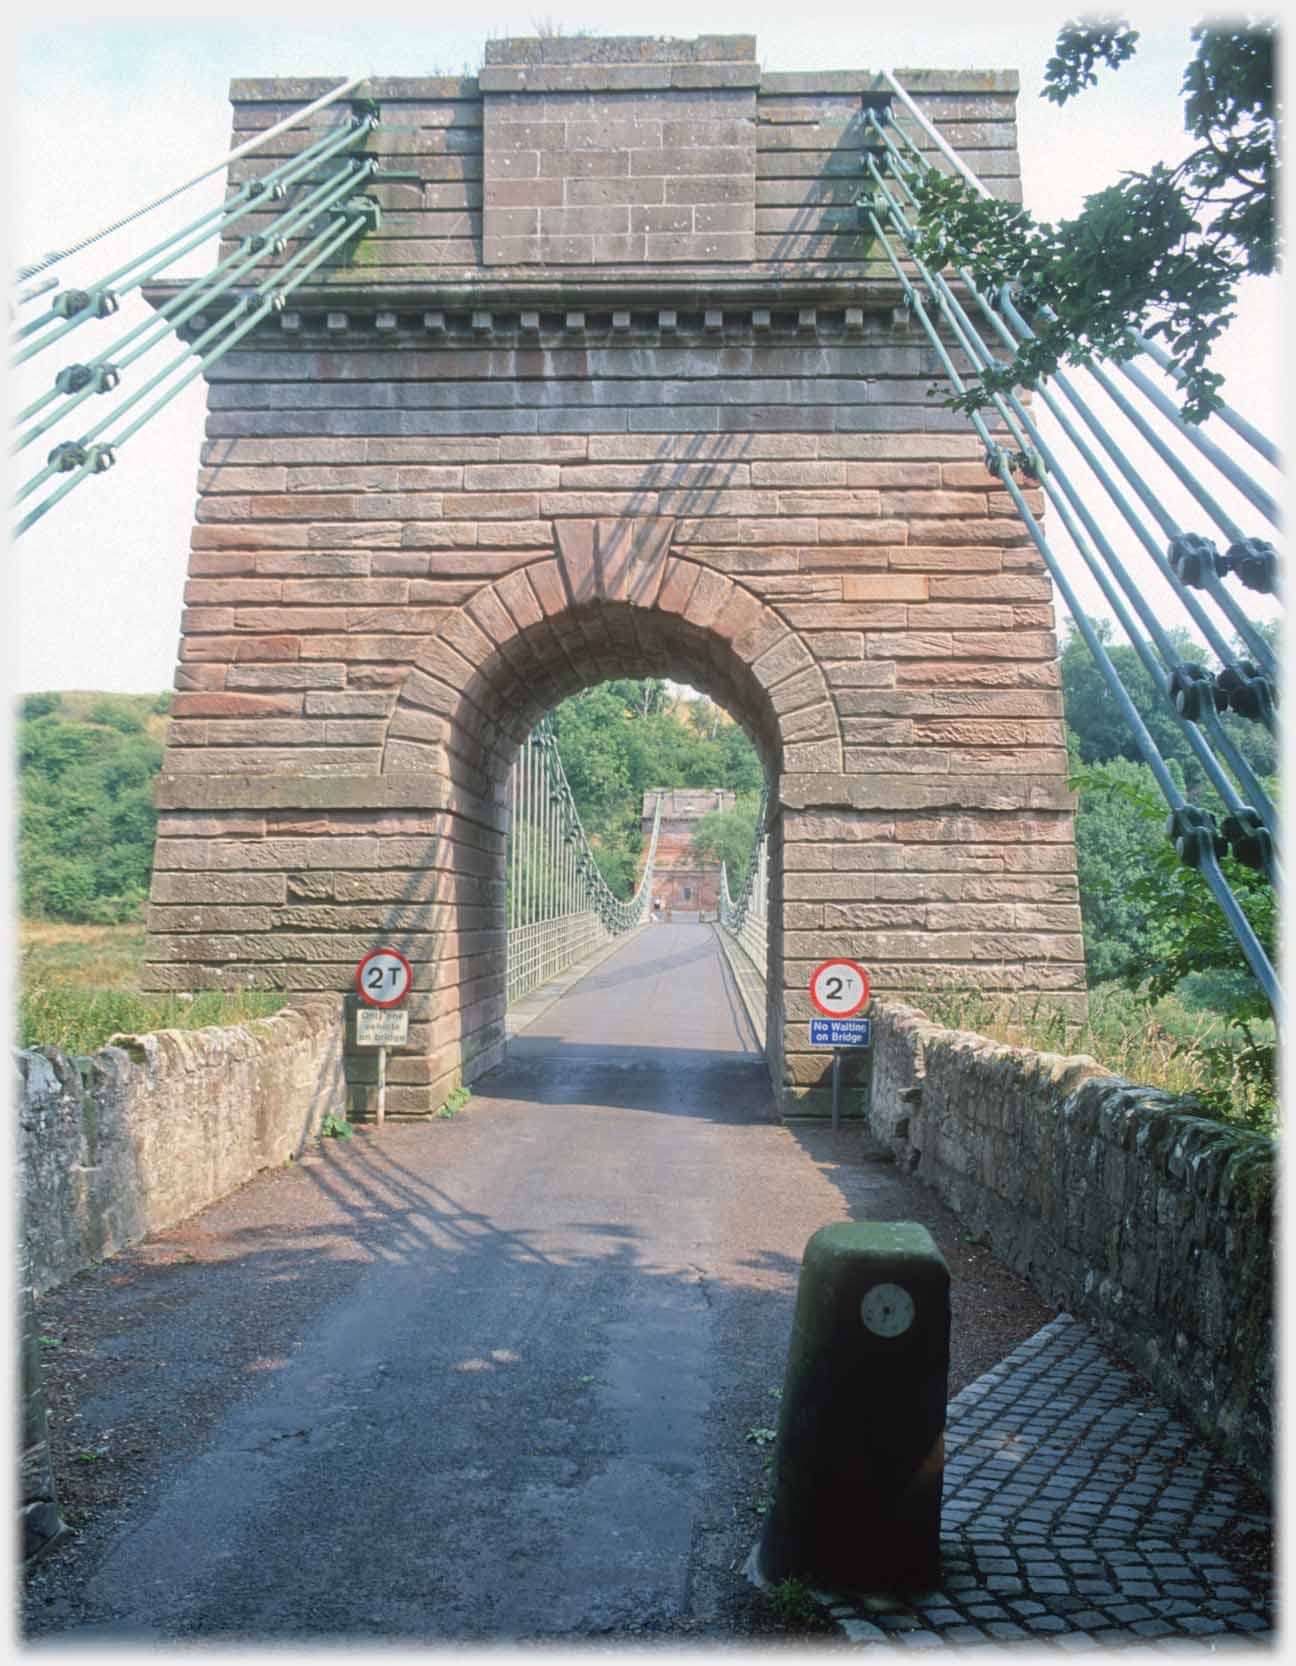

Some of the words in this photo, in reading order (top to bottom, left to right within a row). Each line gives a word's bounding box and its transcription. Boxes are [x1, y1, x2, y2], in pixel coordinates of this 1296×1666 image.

[368, 967, 401, 988] 2T
[826, 977, 854, 1000] 2T
[814, 1022, 829, 1031] No
[831, 1022, 867, 1033] Waiting
[831, 1032, 863, 1043] Bridge
